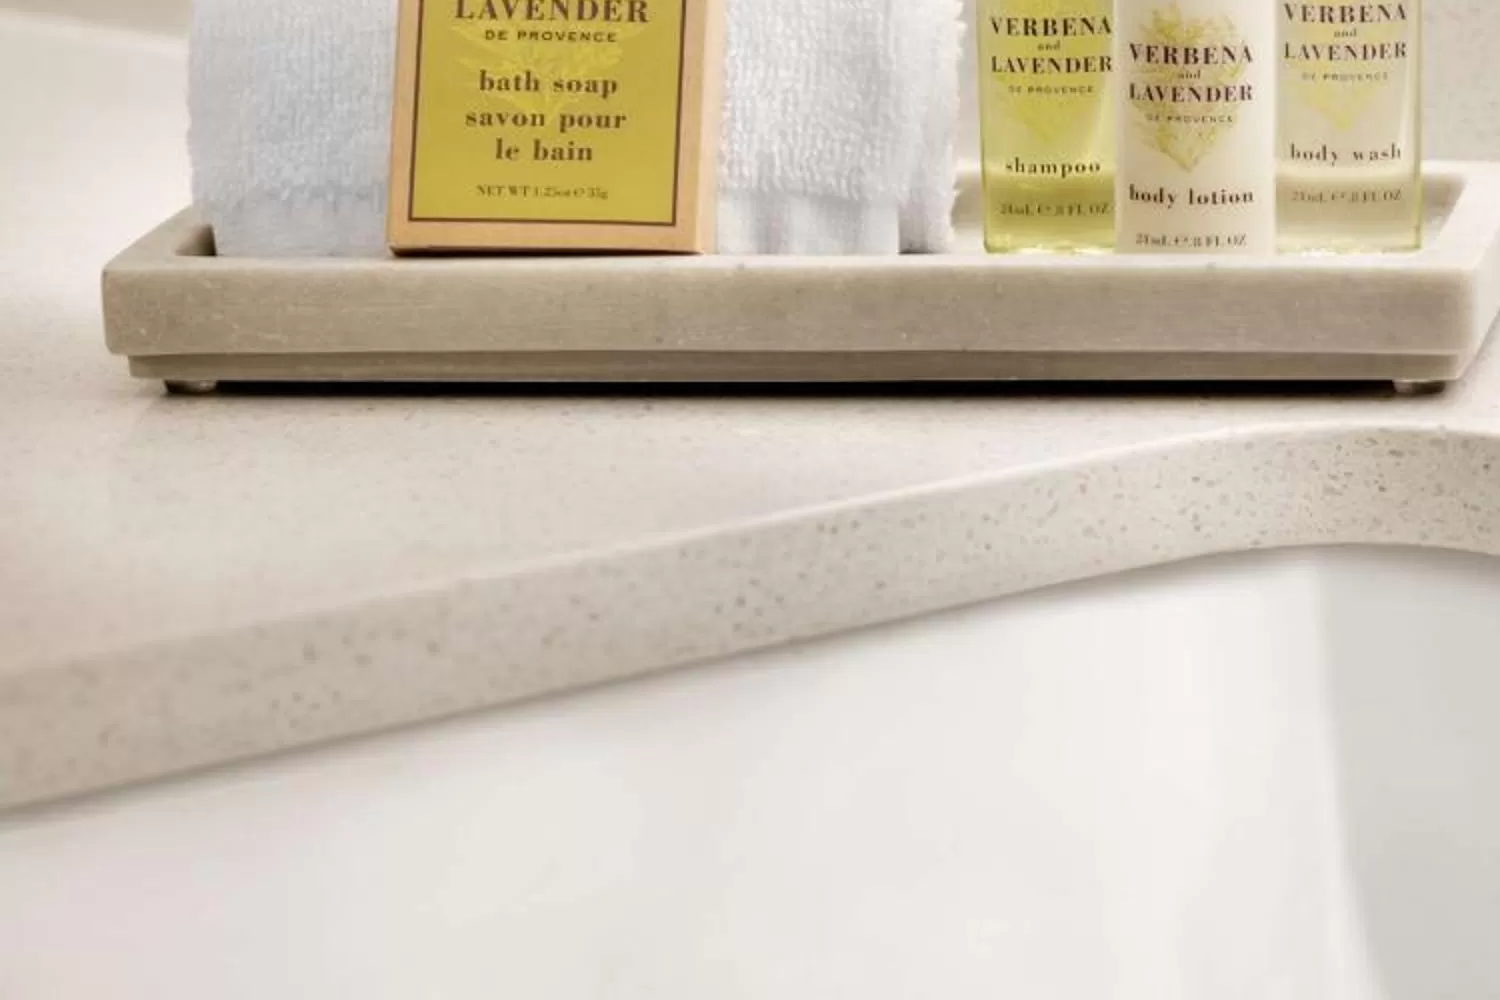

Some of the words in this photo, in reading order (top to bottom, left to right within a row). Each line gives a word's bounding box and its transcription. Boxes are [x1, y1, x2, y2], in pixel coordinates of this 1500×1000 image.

[1283, 3, 1407, 23] VERBENA
[485, 30, 508, 41] DE
[517, 30, 618, 43] PROVENCE
[989, 16, 1112, 37] VERBENA
[1333, 28, 1357, 38] and
[1037, 40, 1061, 51] and
[1129, 42, 1253, 65] VERBENA
[1283, 41, 1408, 61] LAVENDER
[990, 55, 1112, 74] LAVENDER
[1177, 69, 1201, 80] and
[479, 69, 541, 92] bath
[553, 78, 617, 99] soap
[1129, 82, 1253, 103] LAVENDER
[465, 111, 545, 127] savon
[559, 113, 627, 133] pour
[495, 137, 520, 160] le
[533, 138, 593, 161] bain
[1290, 142, 1338, 167] body
[1353, 141, 1402, 161] wash
[1005, 156, 1101, 179] shampoo
[476, 184, 505, 197] NET
[508, 185, 530, 197] WT
[1129, 183, 1175, 209] body
[1188, 187, 1254, 205] lotion
